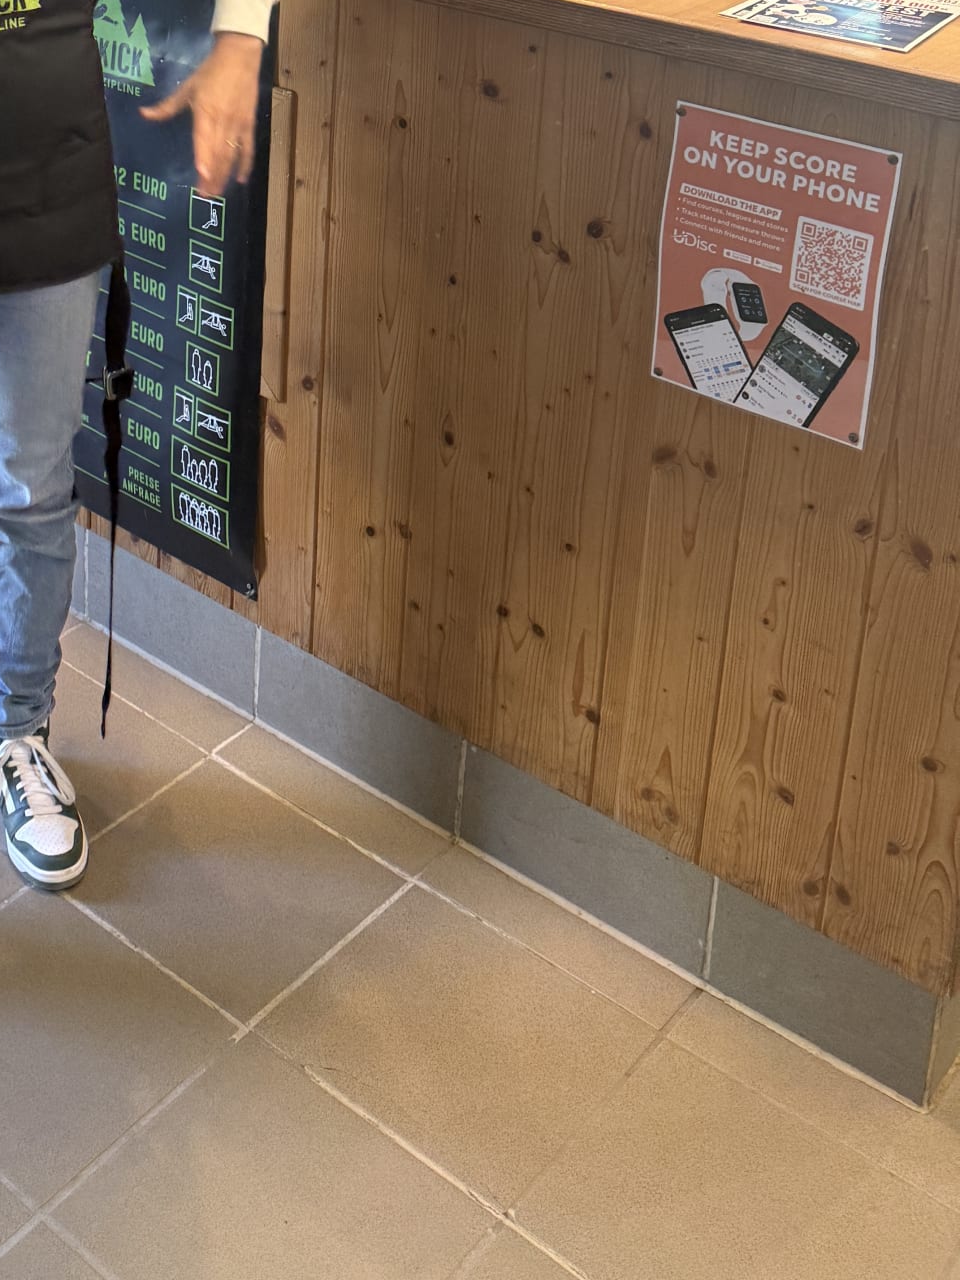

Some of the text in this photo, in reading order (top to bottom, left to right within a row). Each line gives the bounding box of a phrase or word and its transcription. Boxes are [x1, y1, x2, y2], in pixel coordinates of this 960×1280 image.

[99, 37, 143, 77] KICK
[709, 130, 857, 184] KEEP SCORE
[133, 171, 168, 201] EURO
[683, 146, 881, 213] ON YOUR PHONE
[682, 197, 697, 207] Find
[725, 209, 752, 223] leagues
[752, 217, 766, 226] and
[766, 221, 788, 233] stores
[683, 185, 779, 218] DOWNLOAD THE APP
[131, 222, 166, 252] EURO
[672, 228, 718, 254] UDisc
[680, 217, 781, 252] Connect with friends and more
[682, 207, 785, 242] Track stats and measure throws
[133, 271, 167, 302] EURO
[131, 320, 164, 352] EURO
[127, 417, 160, 451] EURO
[122, 477, 161, 507] ANFRAGE
[128, 465, 160, 492] PREISE
